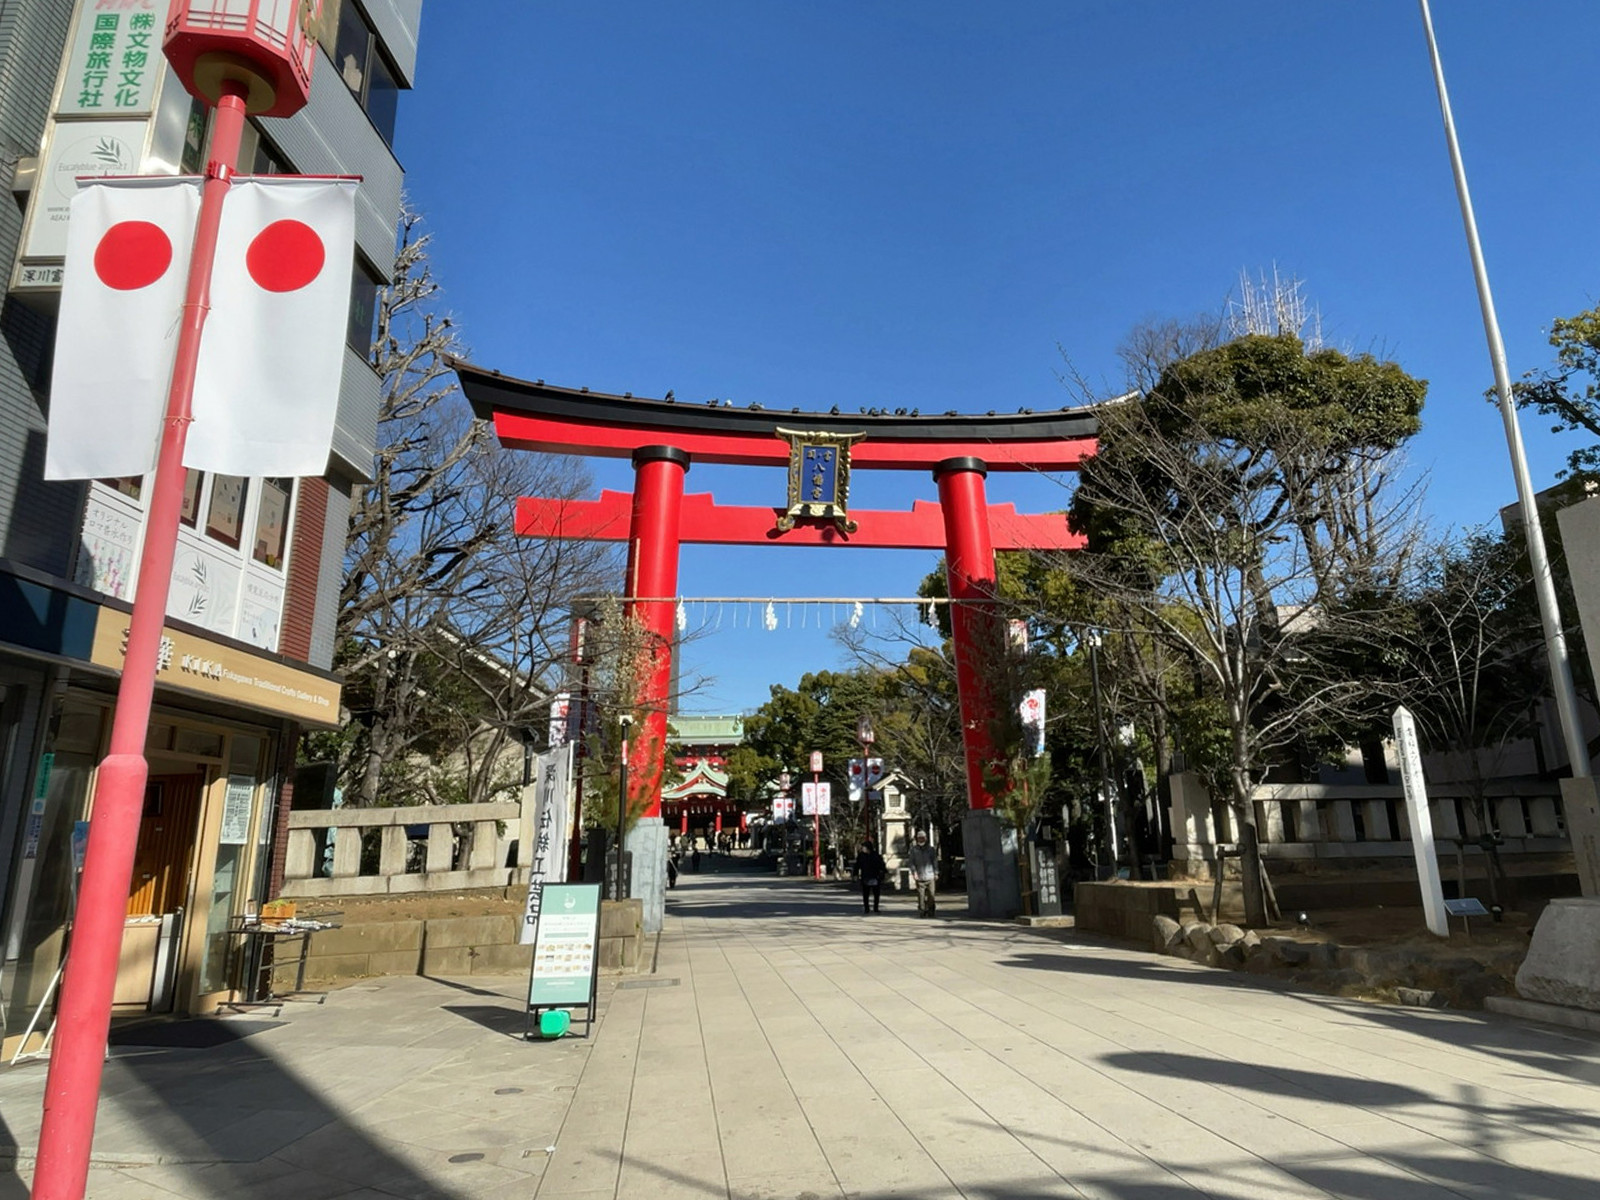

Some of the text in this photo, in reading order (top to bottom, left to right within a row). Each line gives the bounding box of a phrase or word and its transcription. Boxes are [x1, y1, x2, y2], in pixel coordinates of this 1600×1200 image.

[77, 14, 120, 108] 国際旅行社
